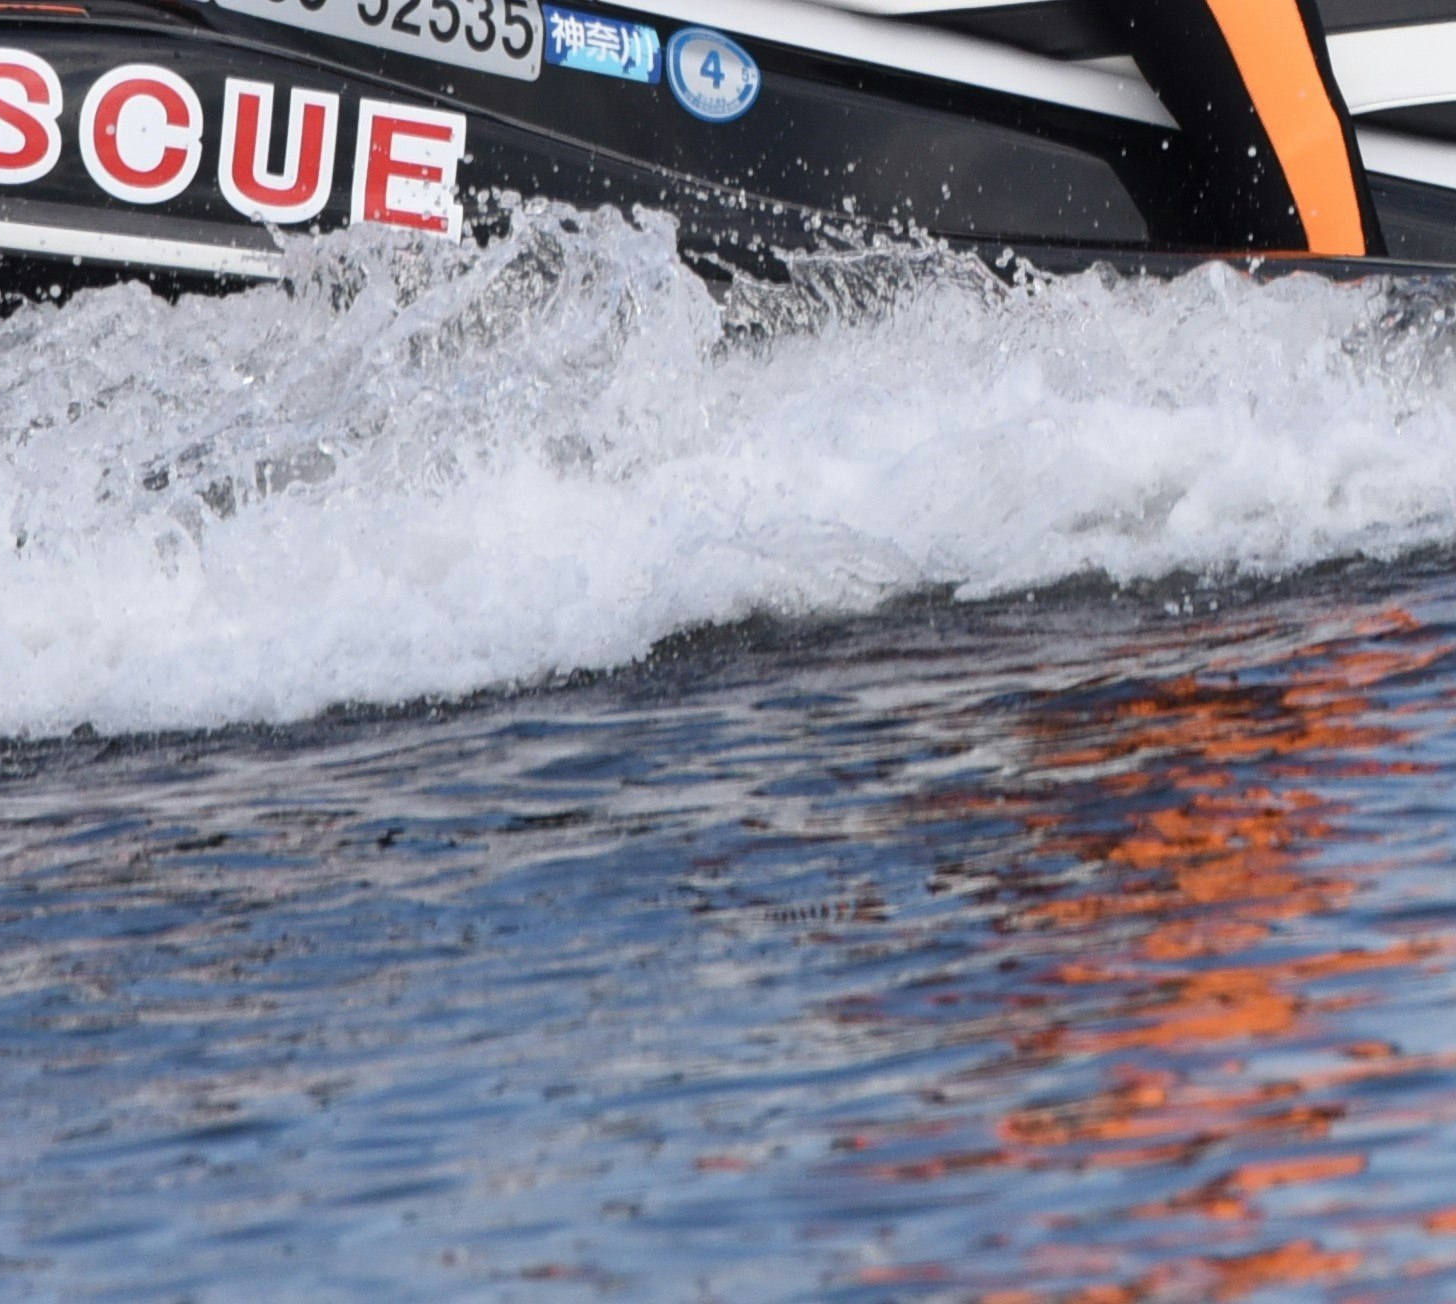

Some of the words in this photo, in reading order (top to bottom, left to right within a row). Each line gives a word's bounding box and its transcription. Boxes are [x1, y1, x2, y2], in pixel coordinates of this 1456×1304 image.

[550, 10, 655, 73] 神奈川
[700, 49, 726, 90] 4
